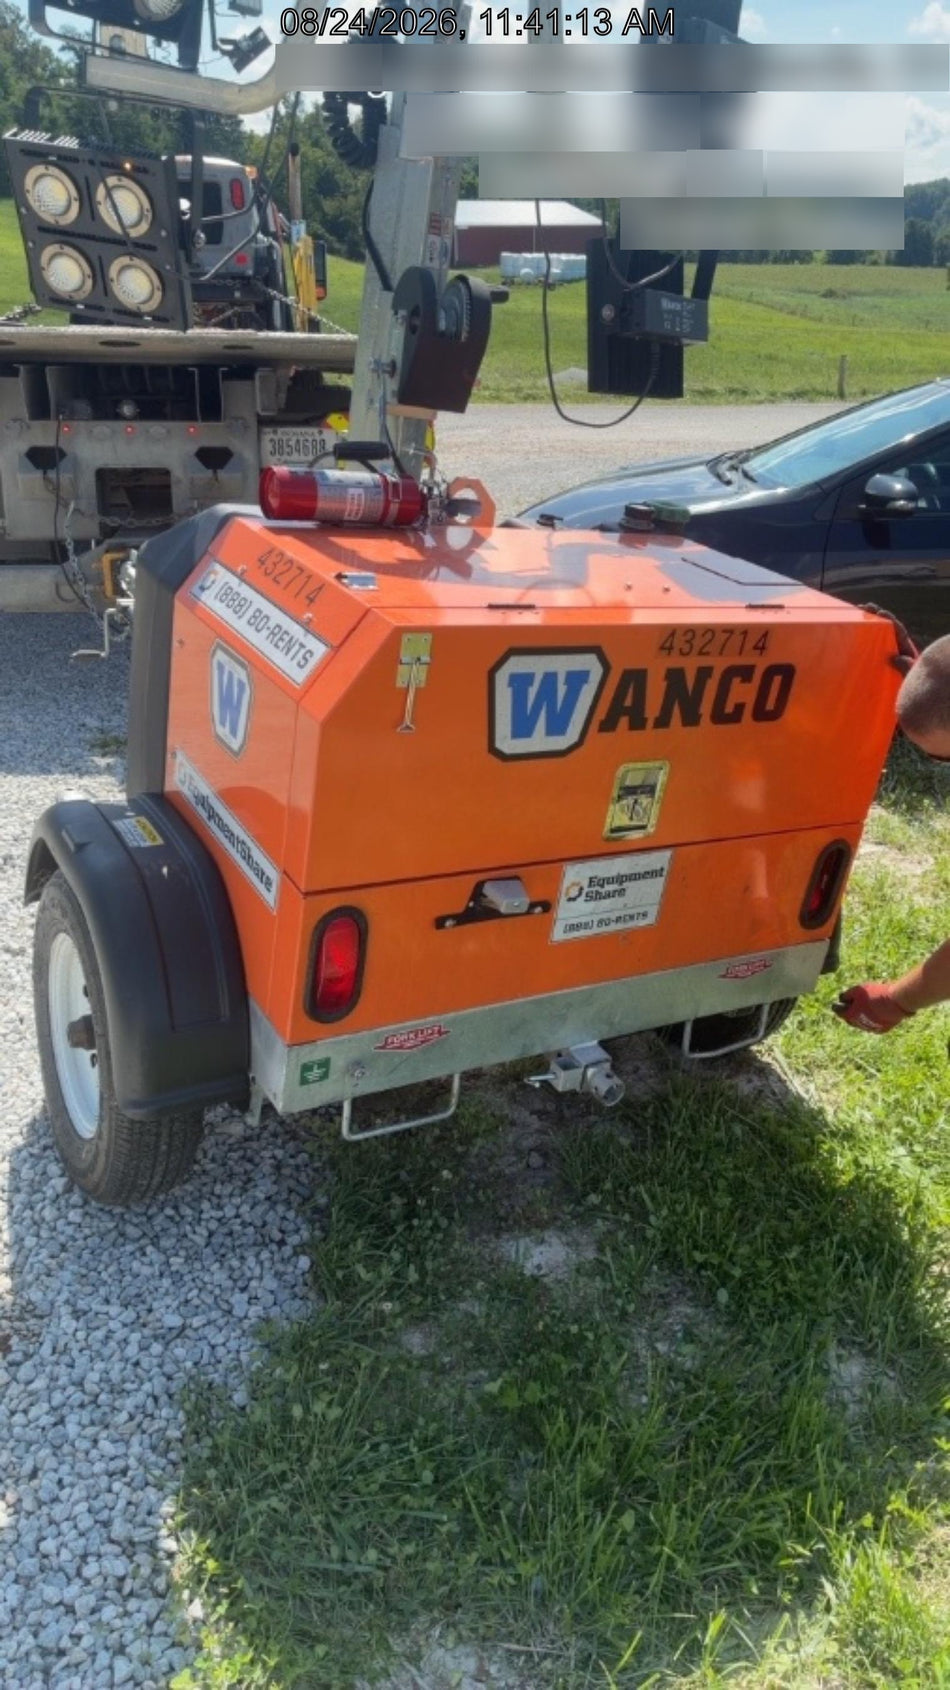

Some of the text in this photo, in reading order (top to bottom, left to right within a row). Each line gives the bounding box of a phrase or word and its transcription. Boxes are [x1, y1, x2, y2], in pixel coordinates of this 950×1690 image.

[257, 548, 325, 607] 432714
[214, 581, 314, 670] (888) 80-RENTS
[659, 628, 770, 657] 432714
[507, 662, 796, 740] WANCO
[584, 887, 627, 903] Share
[586, 867, 665, 890] Equipment
